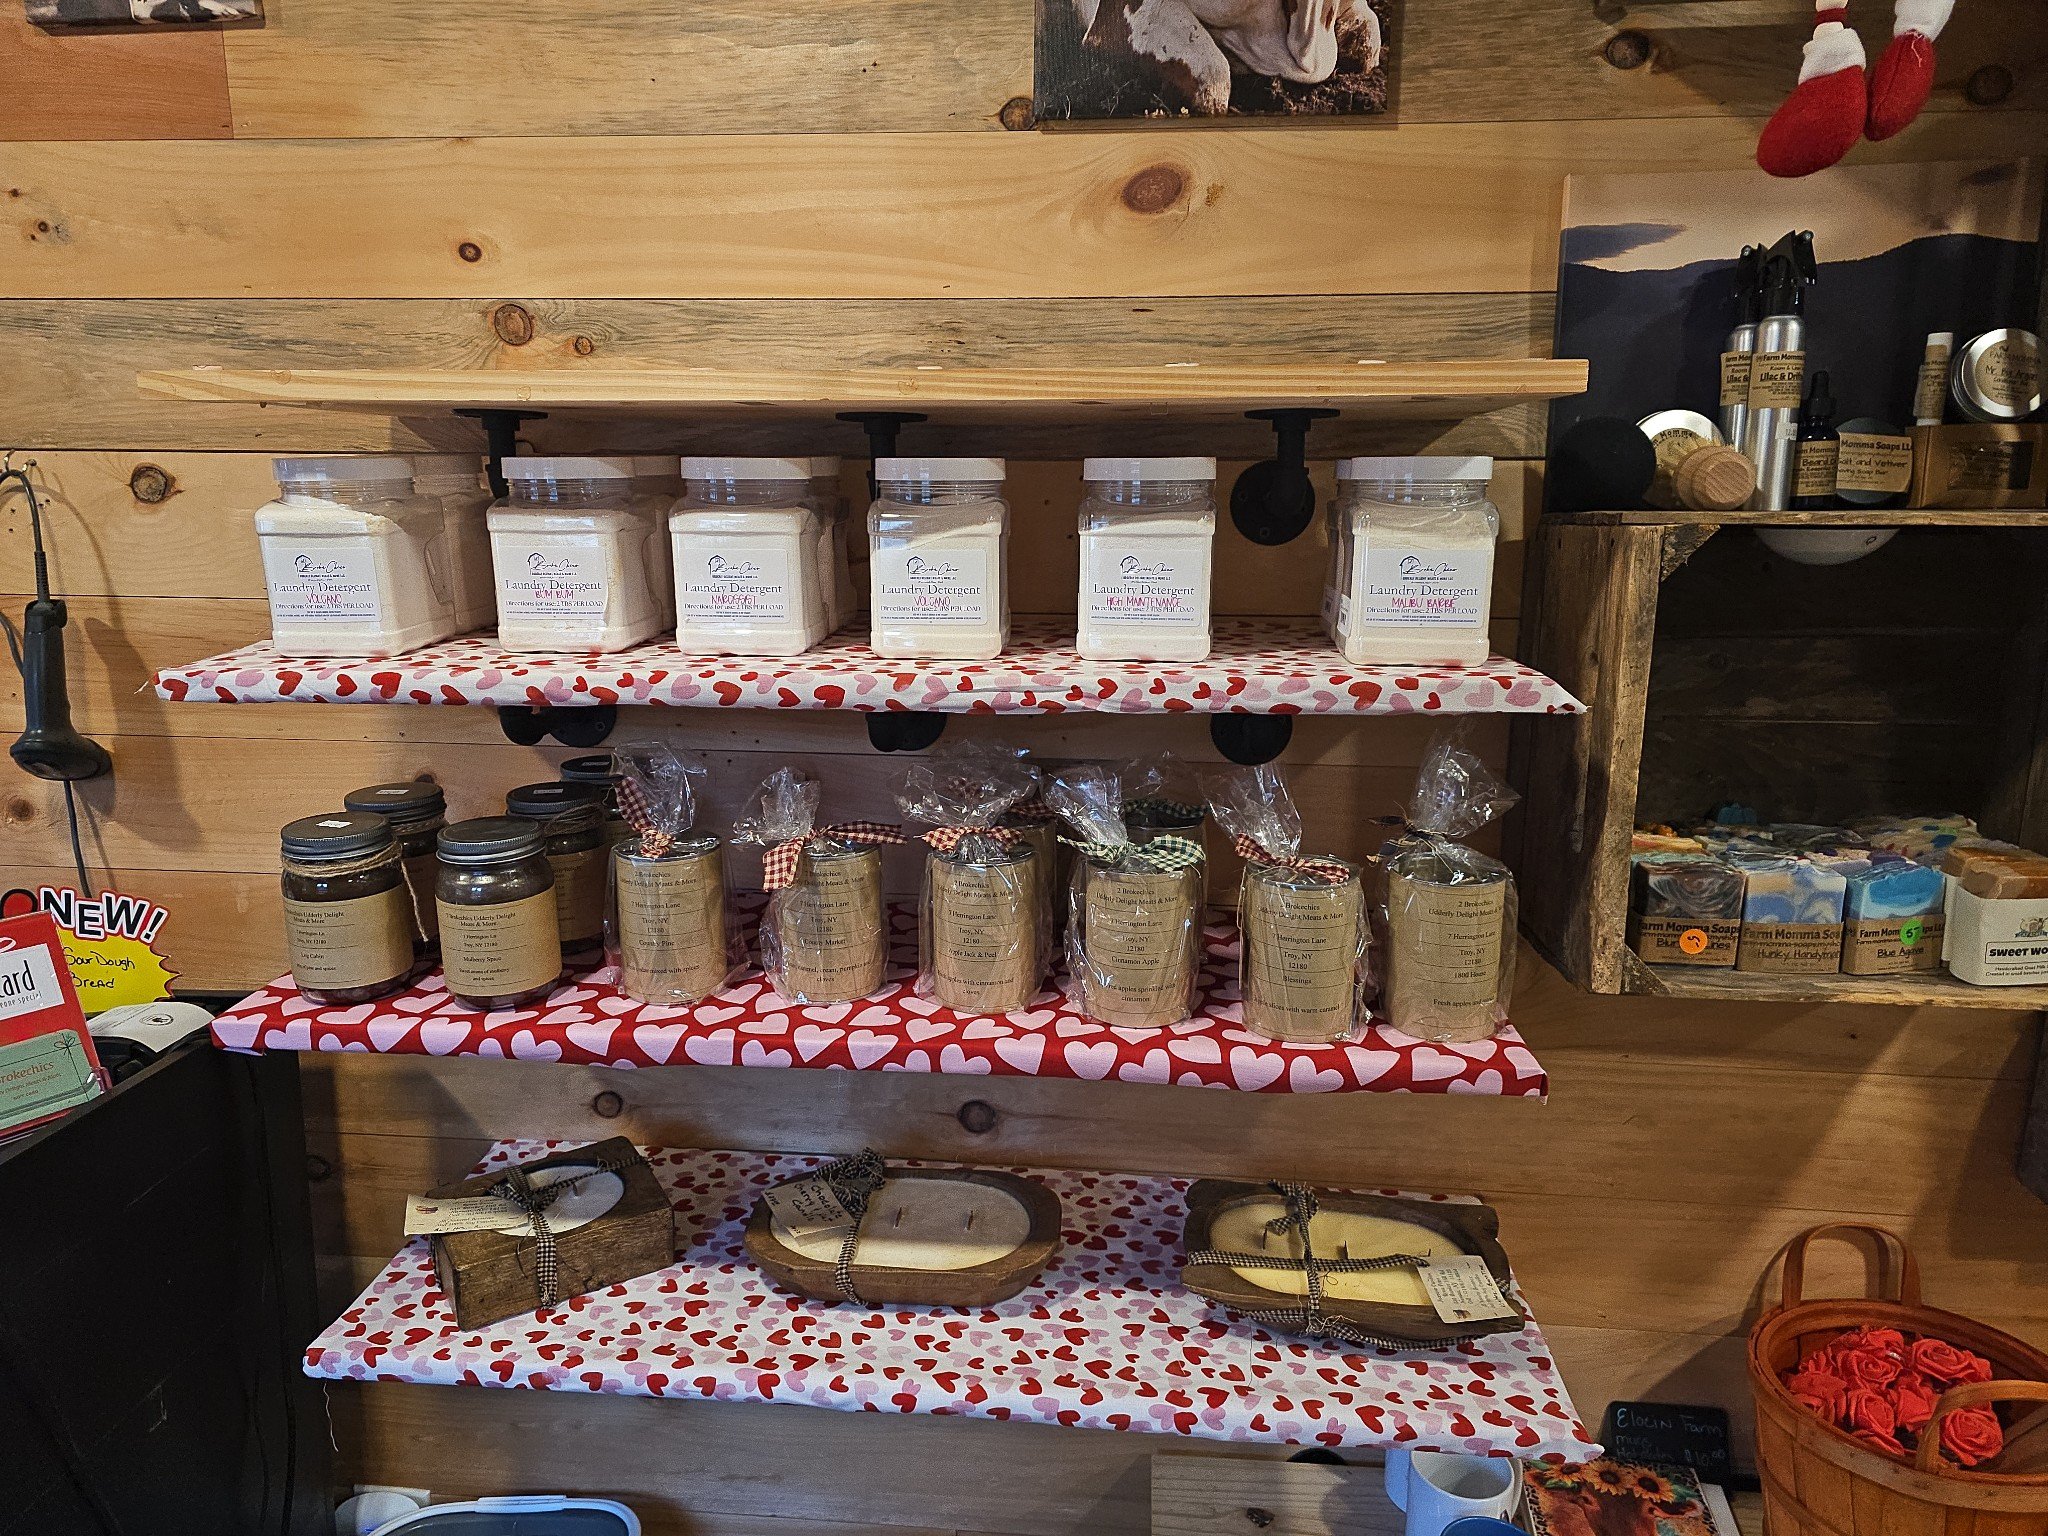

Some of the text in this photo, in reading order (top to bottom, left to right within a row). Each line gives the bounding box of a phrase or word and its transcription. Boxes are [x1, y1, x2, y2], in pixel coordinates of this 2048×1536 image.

[1760, 372, 1779, 382] Lilac
[1841, 440, 1913, 452] Momma Soaps LL
[273, 582, 372, 594] Laundry Detergent
[505, 580, 602, 592] Laundry Detergent
[685, 583, 782, 596] Laundry Detergent
[881, 584, 981, 598] Laundry Detergent
[1092, 583, 1195, 598] Laundry Detergent
[1369, 584, 1479, 600] Laundry Detergent
[1285, 903, 1320, 911] Brokechics
[42, 888, 168, 942] NEW!
[1428, 908, 1479, 919] Udderly Delight
[1774, 928, 1820, 940] Momma
[1860, 929, 1880, 938] Farm
[963, 937, 980, 945] 12180
[1284, 951, 1300, 960] Troy,
[1877, 948, 1896, 958] Blue
[90, 950, 136, 972] Dough
[1142, 958, 1160, 967] Apple
[0, 960, 35, 998] ard
[1283, 976, 1312, 985] Blessings
[1433, 998, 1471, 1008] Fresh apples
[0, 1061, 54, 1084] rokechics
